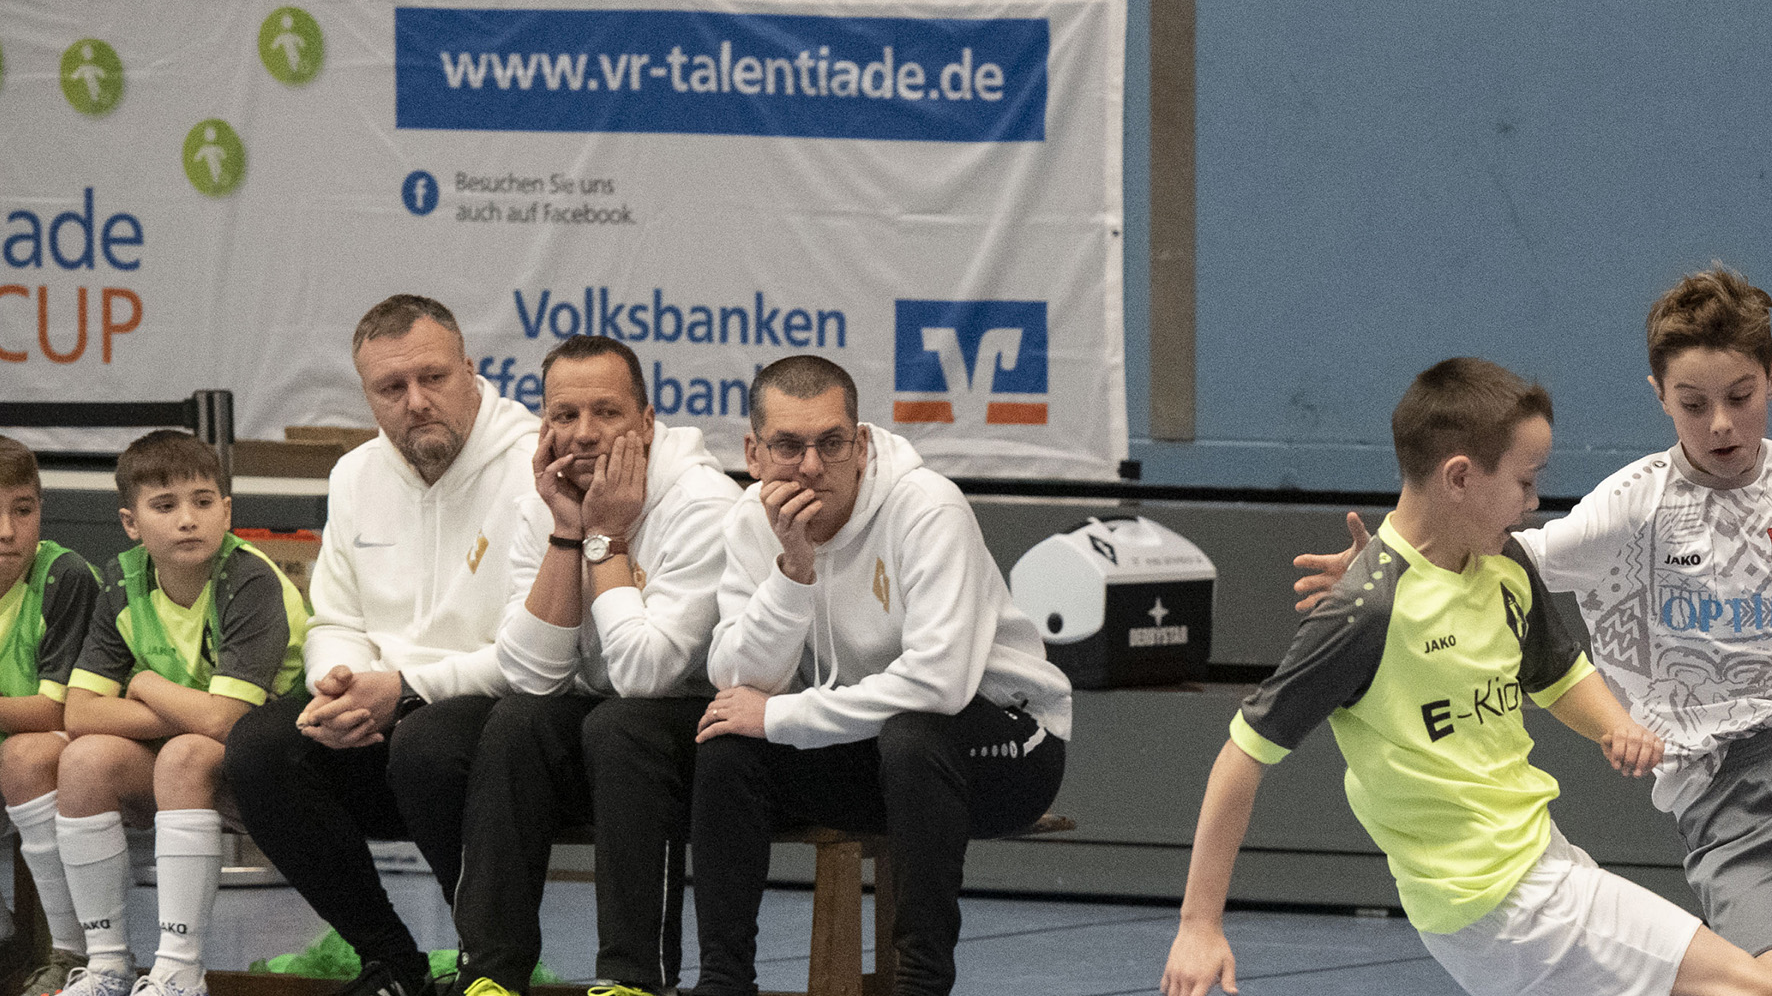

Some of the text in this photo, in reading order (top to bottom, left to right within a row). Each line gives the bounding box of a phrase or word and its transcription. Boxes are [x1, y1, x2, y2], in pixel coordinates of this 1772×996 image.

[440, 40, 1004, 101] www.vr-talentiade.de
[454, 171, 615, 195] Besuchen Sie uns
[455, 201, 502, 223] auch
[506, 202, 538, 223] auf
[514, 286, 847, 348] Volksbanken
[1663, 553, 1702, 567] JAKO
[1424, 634, 1457, 654] JAKO
[1420, 675, 1526, 744] E-Kio
[79, 918, 112, 931] AKO
[160, 921, 189, 935] AKO
